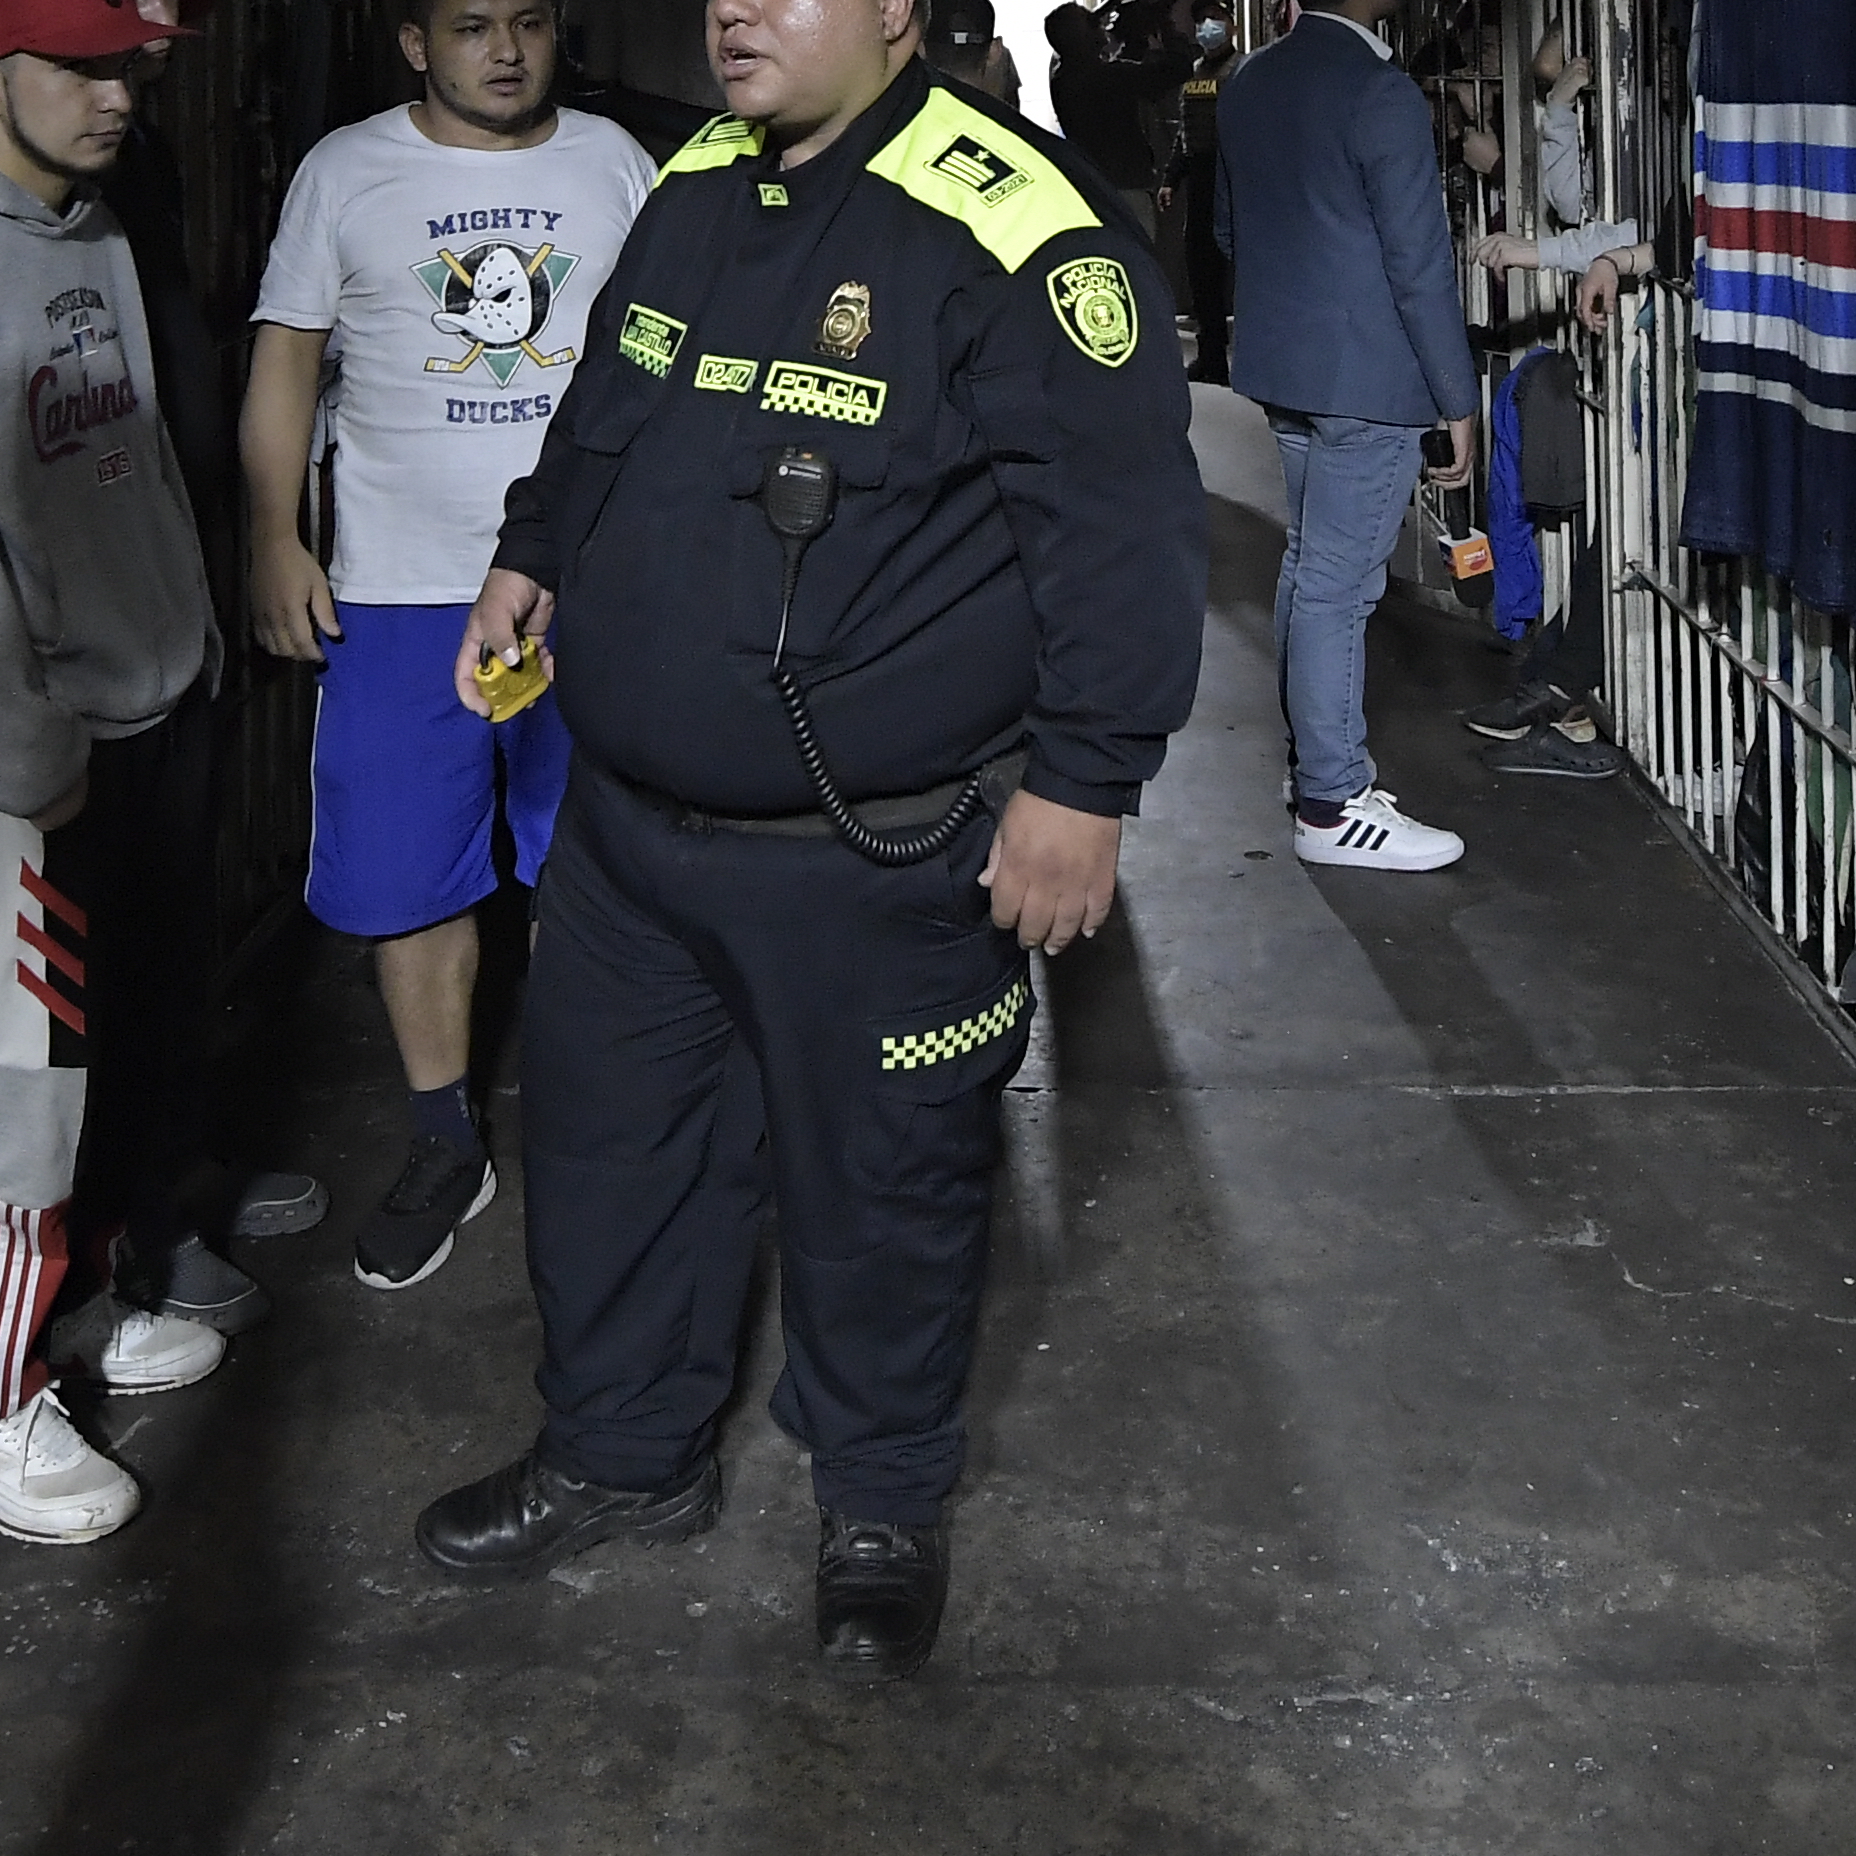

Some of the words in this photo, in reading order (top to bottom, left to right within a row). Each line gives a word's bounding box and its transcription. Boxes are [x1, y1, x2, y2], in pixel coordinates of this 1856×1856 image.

[426, 208, 562, 239] MIGHTY
[1060, 277, 1126, 308] NACIONAL
[777, 372, 870, 407] POLICÍA
[446, 394, 551, 424] DUCKS
